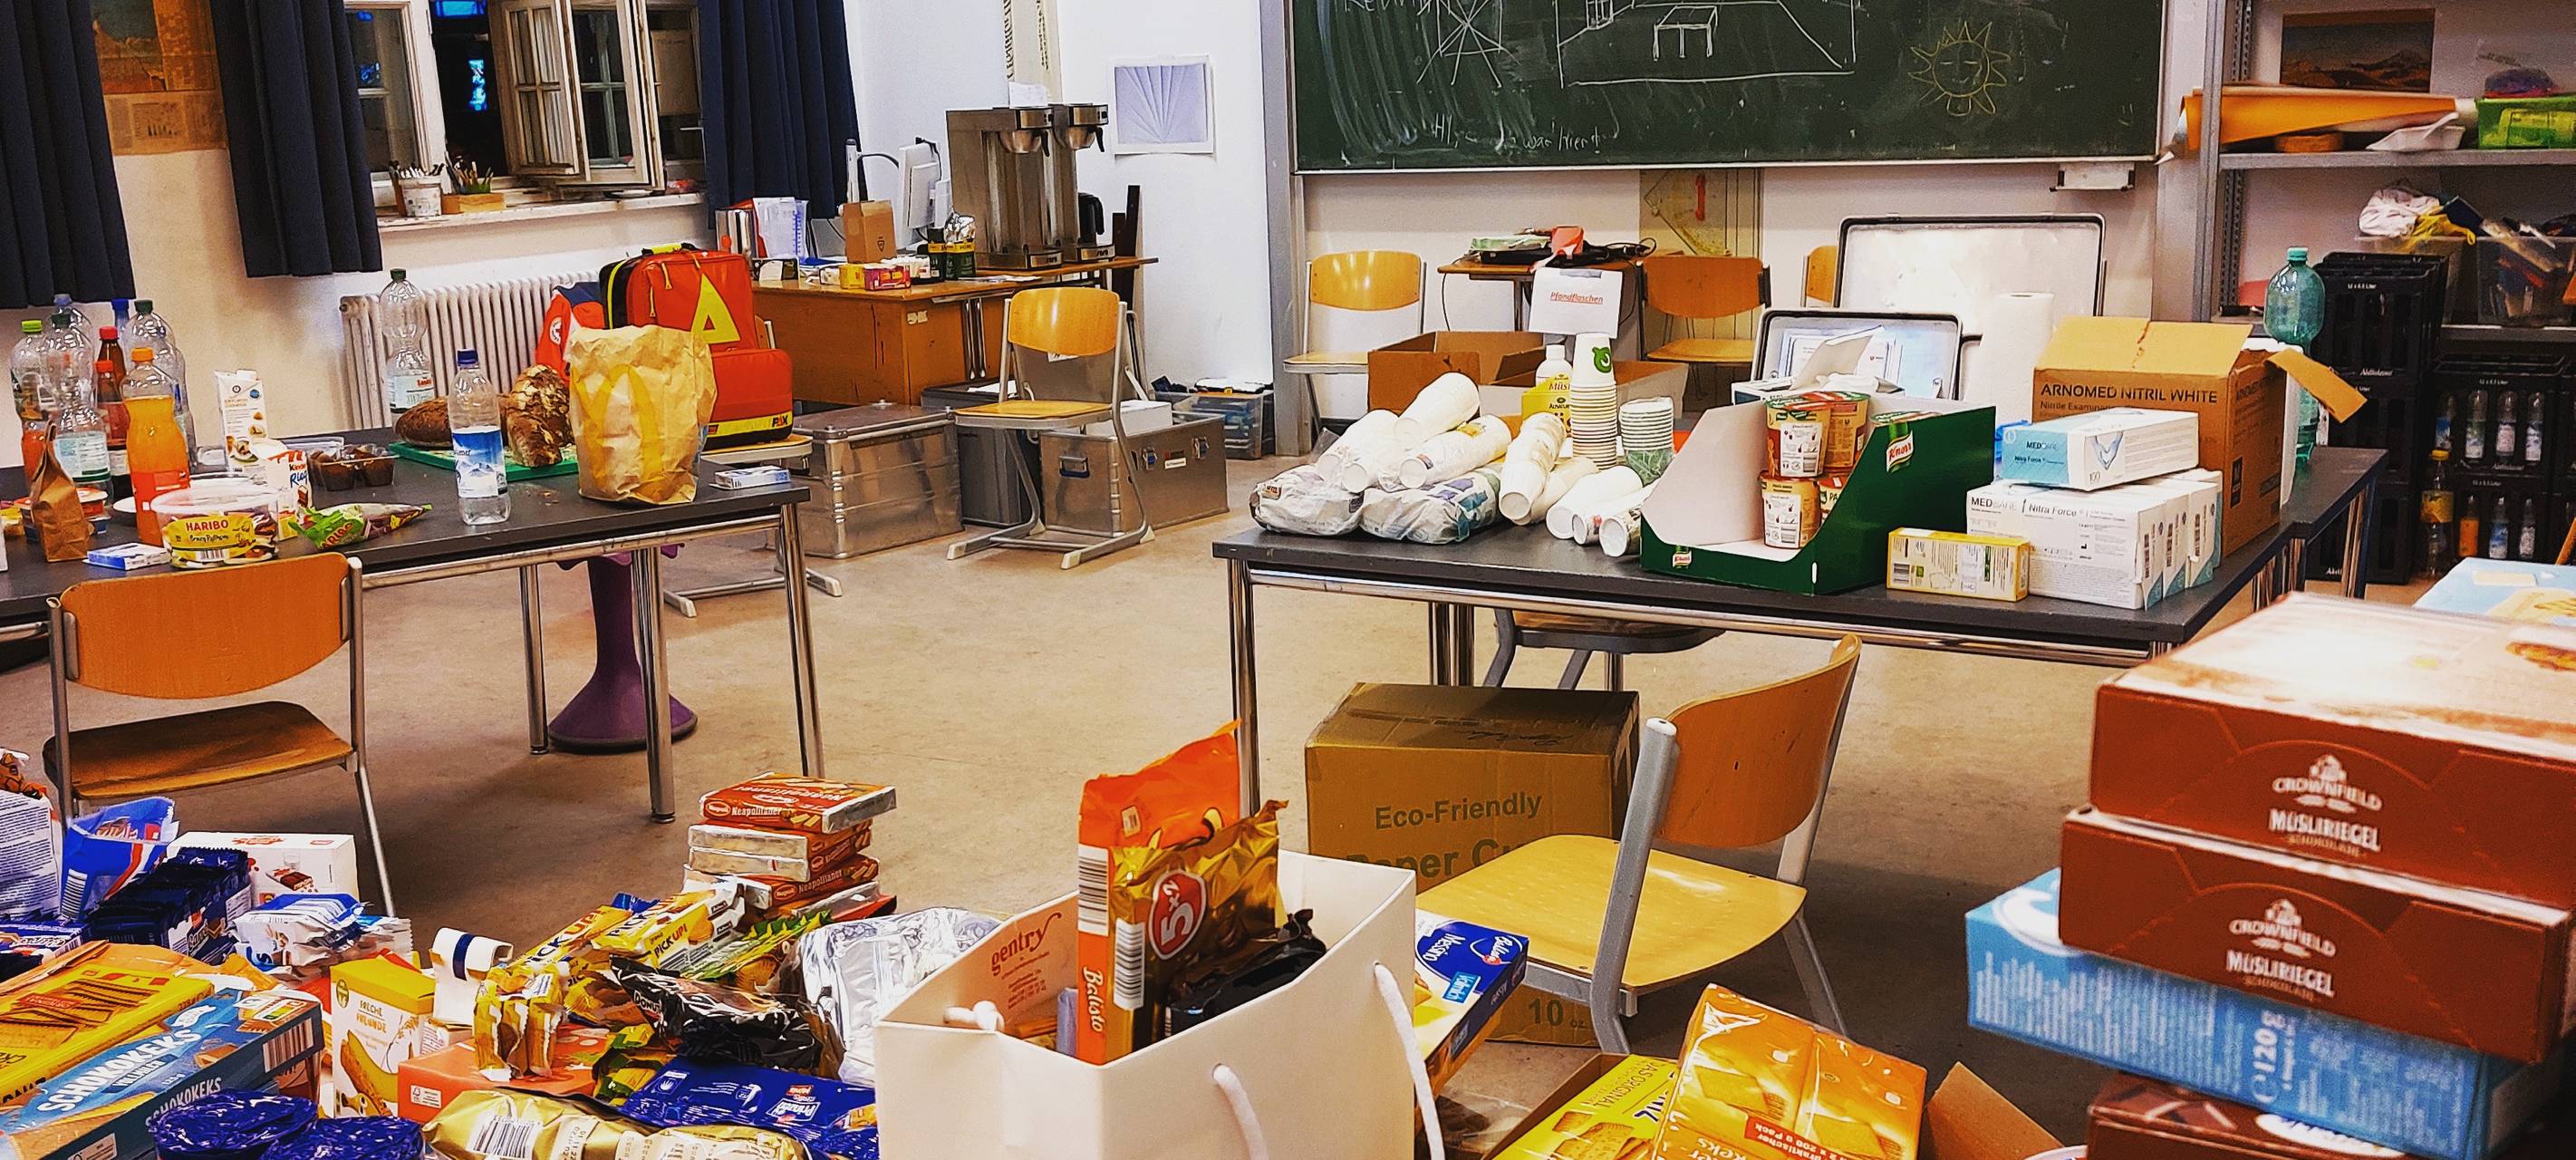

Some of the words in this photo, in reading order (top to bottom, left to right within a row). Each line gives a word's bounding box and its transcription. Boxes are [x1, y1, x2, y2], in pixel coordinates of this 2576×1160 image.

[1550, 291, 1604, 304] Pfandflaschen
[2040, 401, 2066, 410] Nitrile
[2068, 401, 2114, 411] Examina
[2041, 383, 2118, 399] ARNOMED
[2119, 387, 2166, 401] NITRIL
[2169, 389, 2218, 403] WHITE
[771, 414, 788, 428] PAX
[1887, 443, 1913, 461] Knorr
[185, 518, 229, 533] HARIBO
[2028, 504, 2051, 515] Nitra
[2051, 505, 2077, 517] Force
[1375, 792, 1543, 830] Eco-Friendly
[2272, 777, 2383, 812] CROWNFIELD
[2269, 807, 2382, 853] MÜSLIRIEGEL
[652, 934, 674, 959] PICK
[671, 923, 689, 943] UP!
[991, 912, 1062, 977] gentry
[2228, 919, 2337, 958] CROWNFIELD
[2225, 950, 2336, 998] MÜSLIRIEGEL
[1083, 966, 1105, 1033] Balisto
[1529, 998, 1564, 1027] 10
[2253, 1028, 2278, 1074] 120
[36, 1027, 202, 1113] SCHOKOKEKS
[1755, 1123, 1783, 1141] Pack
